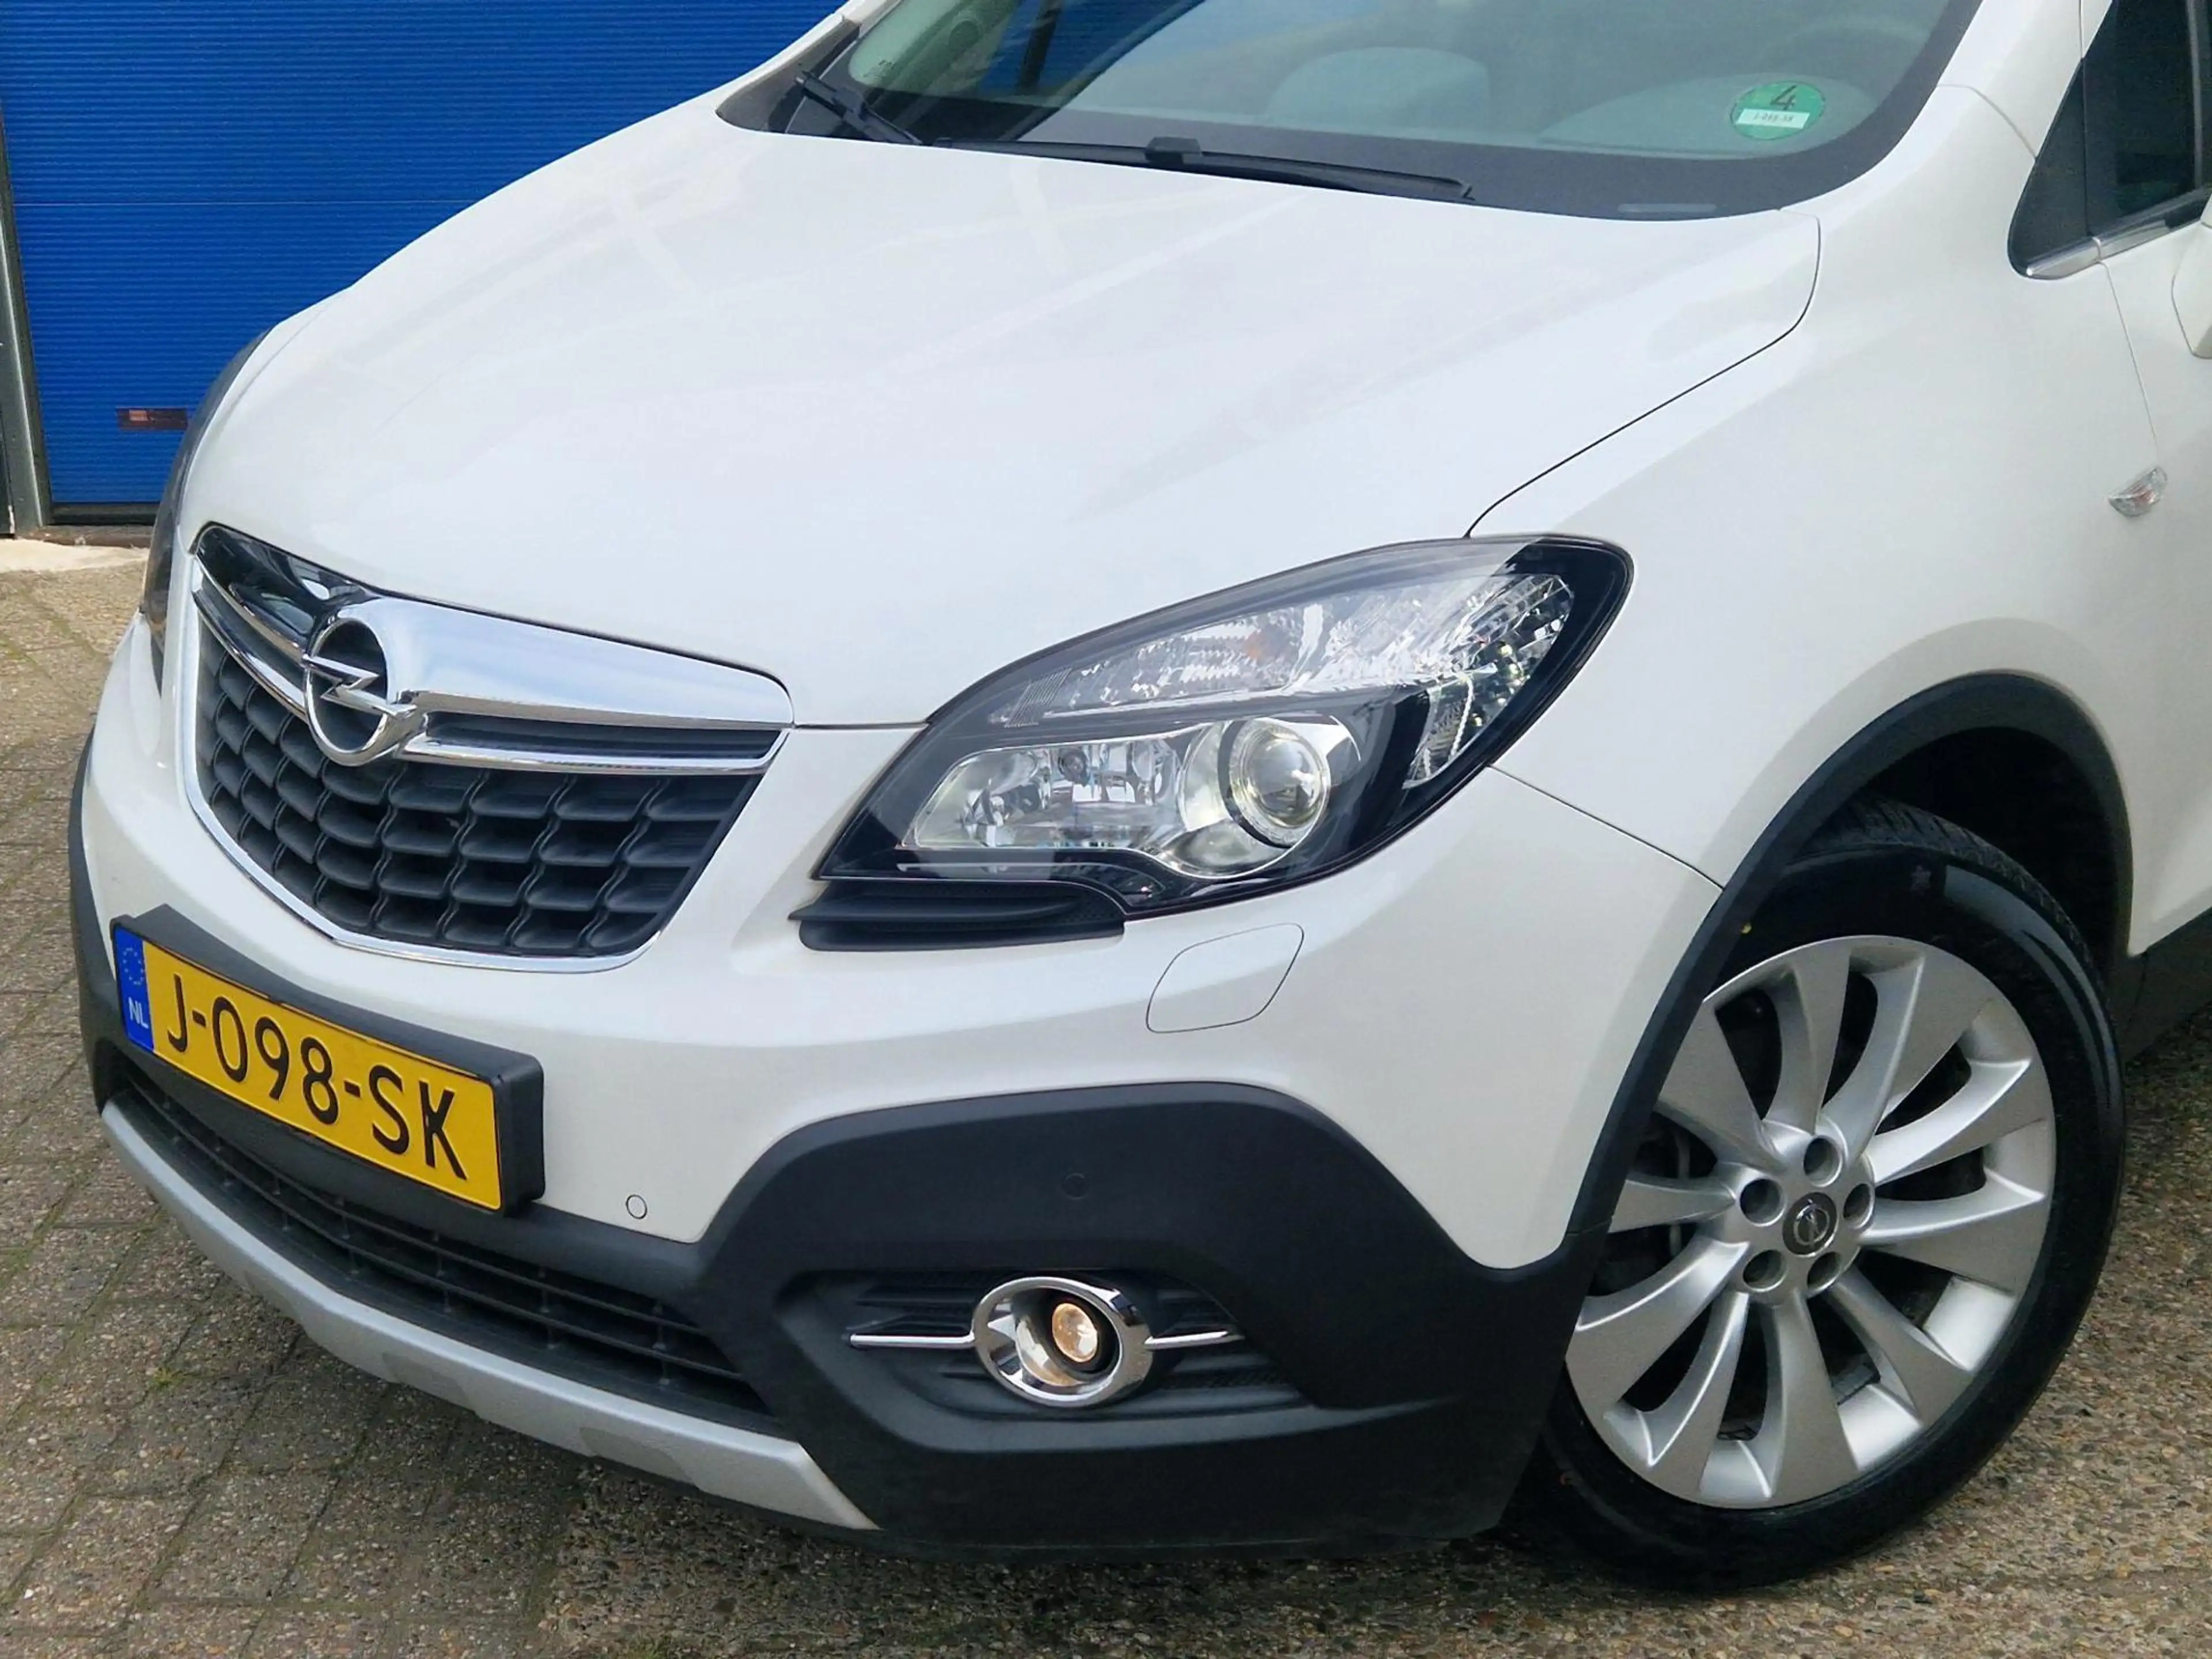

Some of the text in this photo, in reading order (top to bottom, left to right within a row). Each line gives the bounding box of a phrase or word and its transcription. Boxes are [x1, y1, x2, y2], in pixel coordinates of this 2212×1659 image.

[1770, 85, 1797, 110] 4
[128, 997, 149, 1029] NL
[167, 974, 467, 1181] J-098-SK
